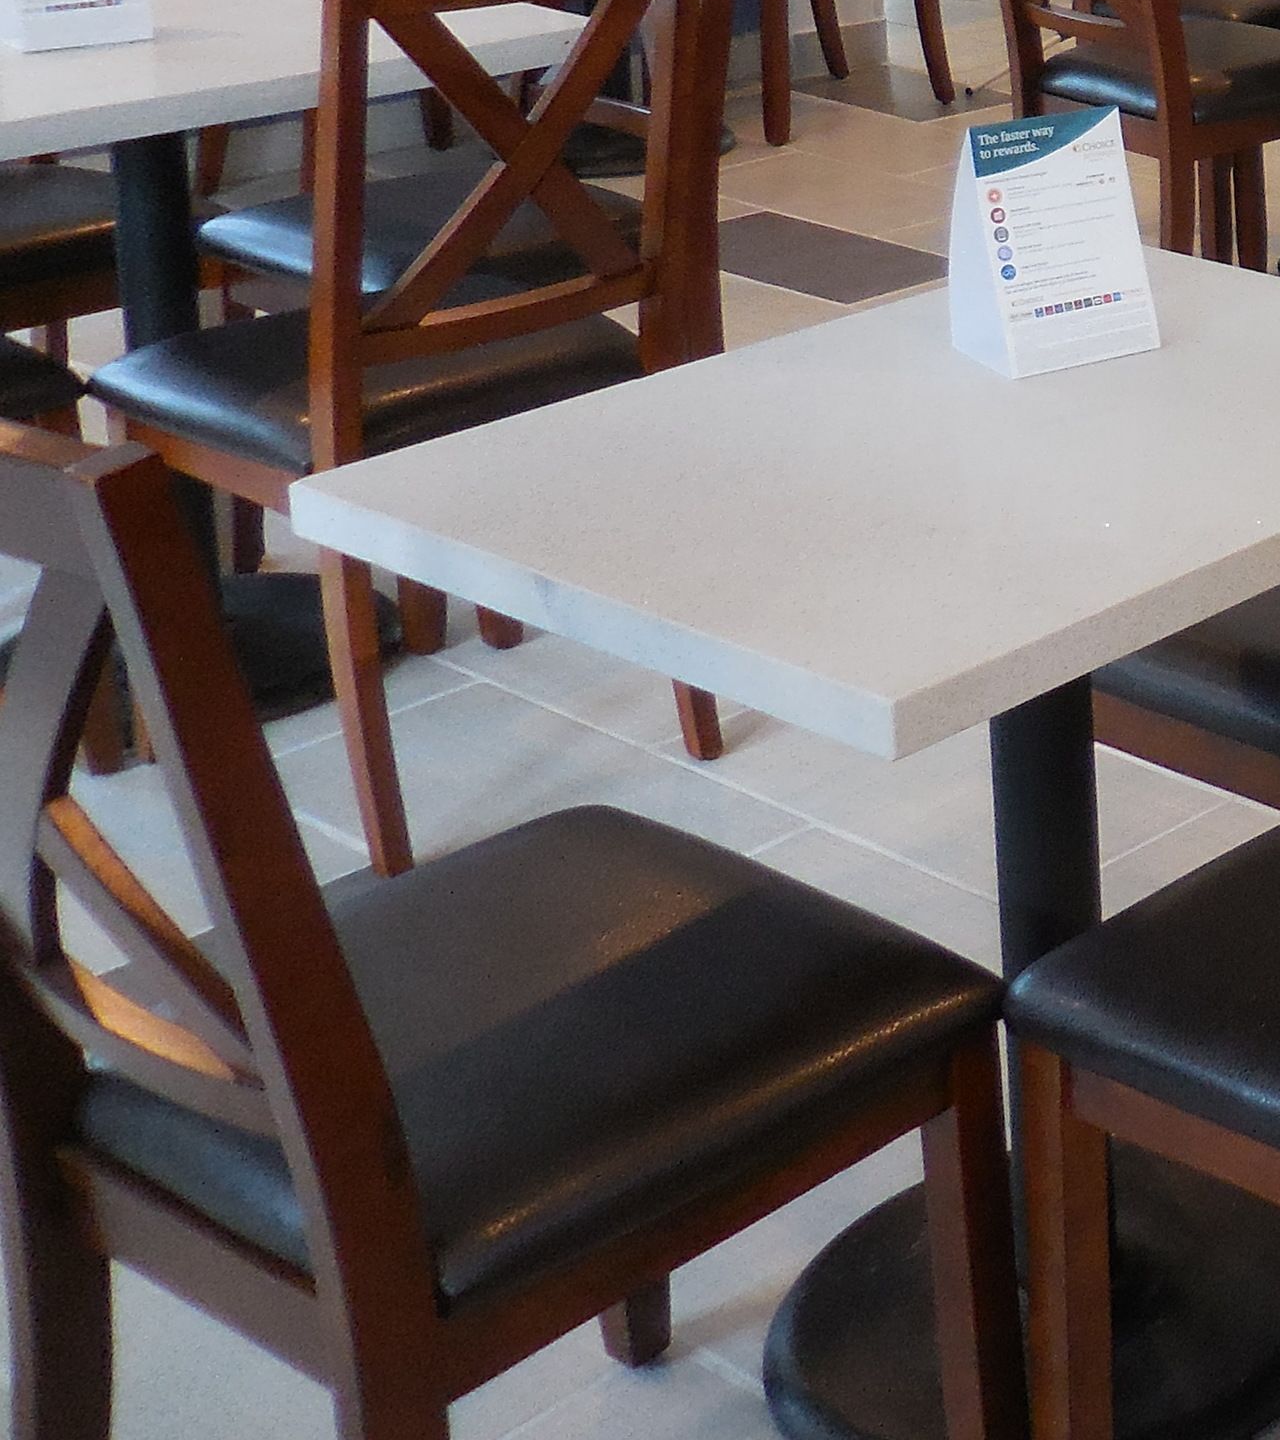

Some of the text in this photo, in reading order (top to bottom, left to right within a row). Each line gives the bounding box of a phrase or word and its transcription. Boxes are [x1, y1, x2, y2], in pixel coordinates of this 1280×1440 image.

[978, 125, 1055, 147] The faster way
[980, 142, 1041, 160] to rewards.
